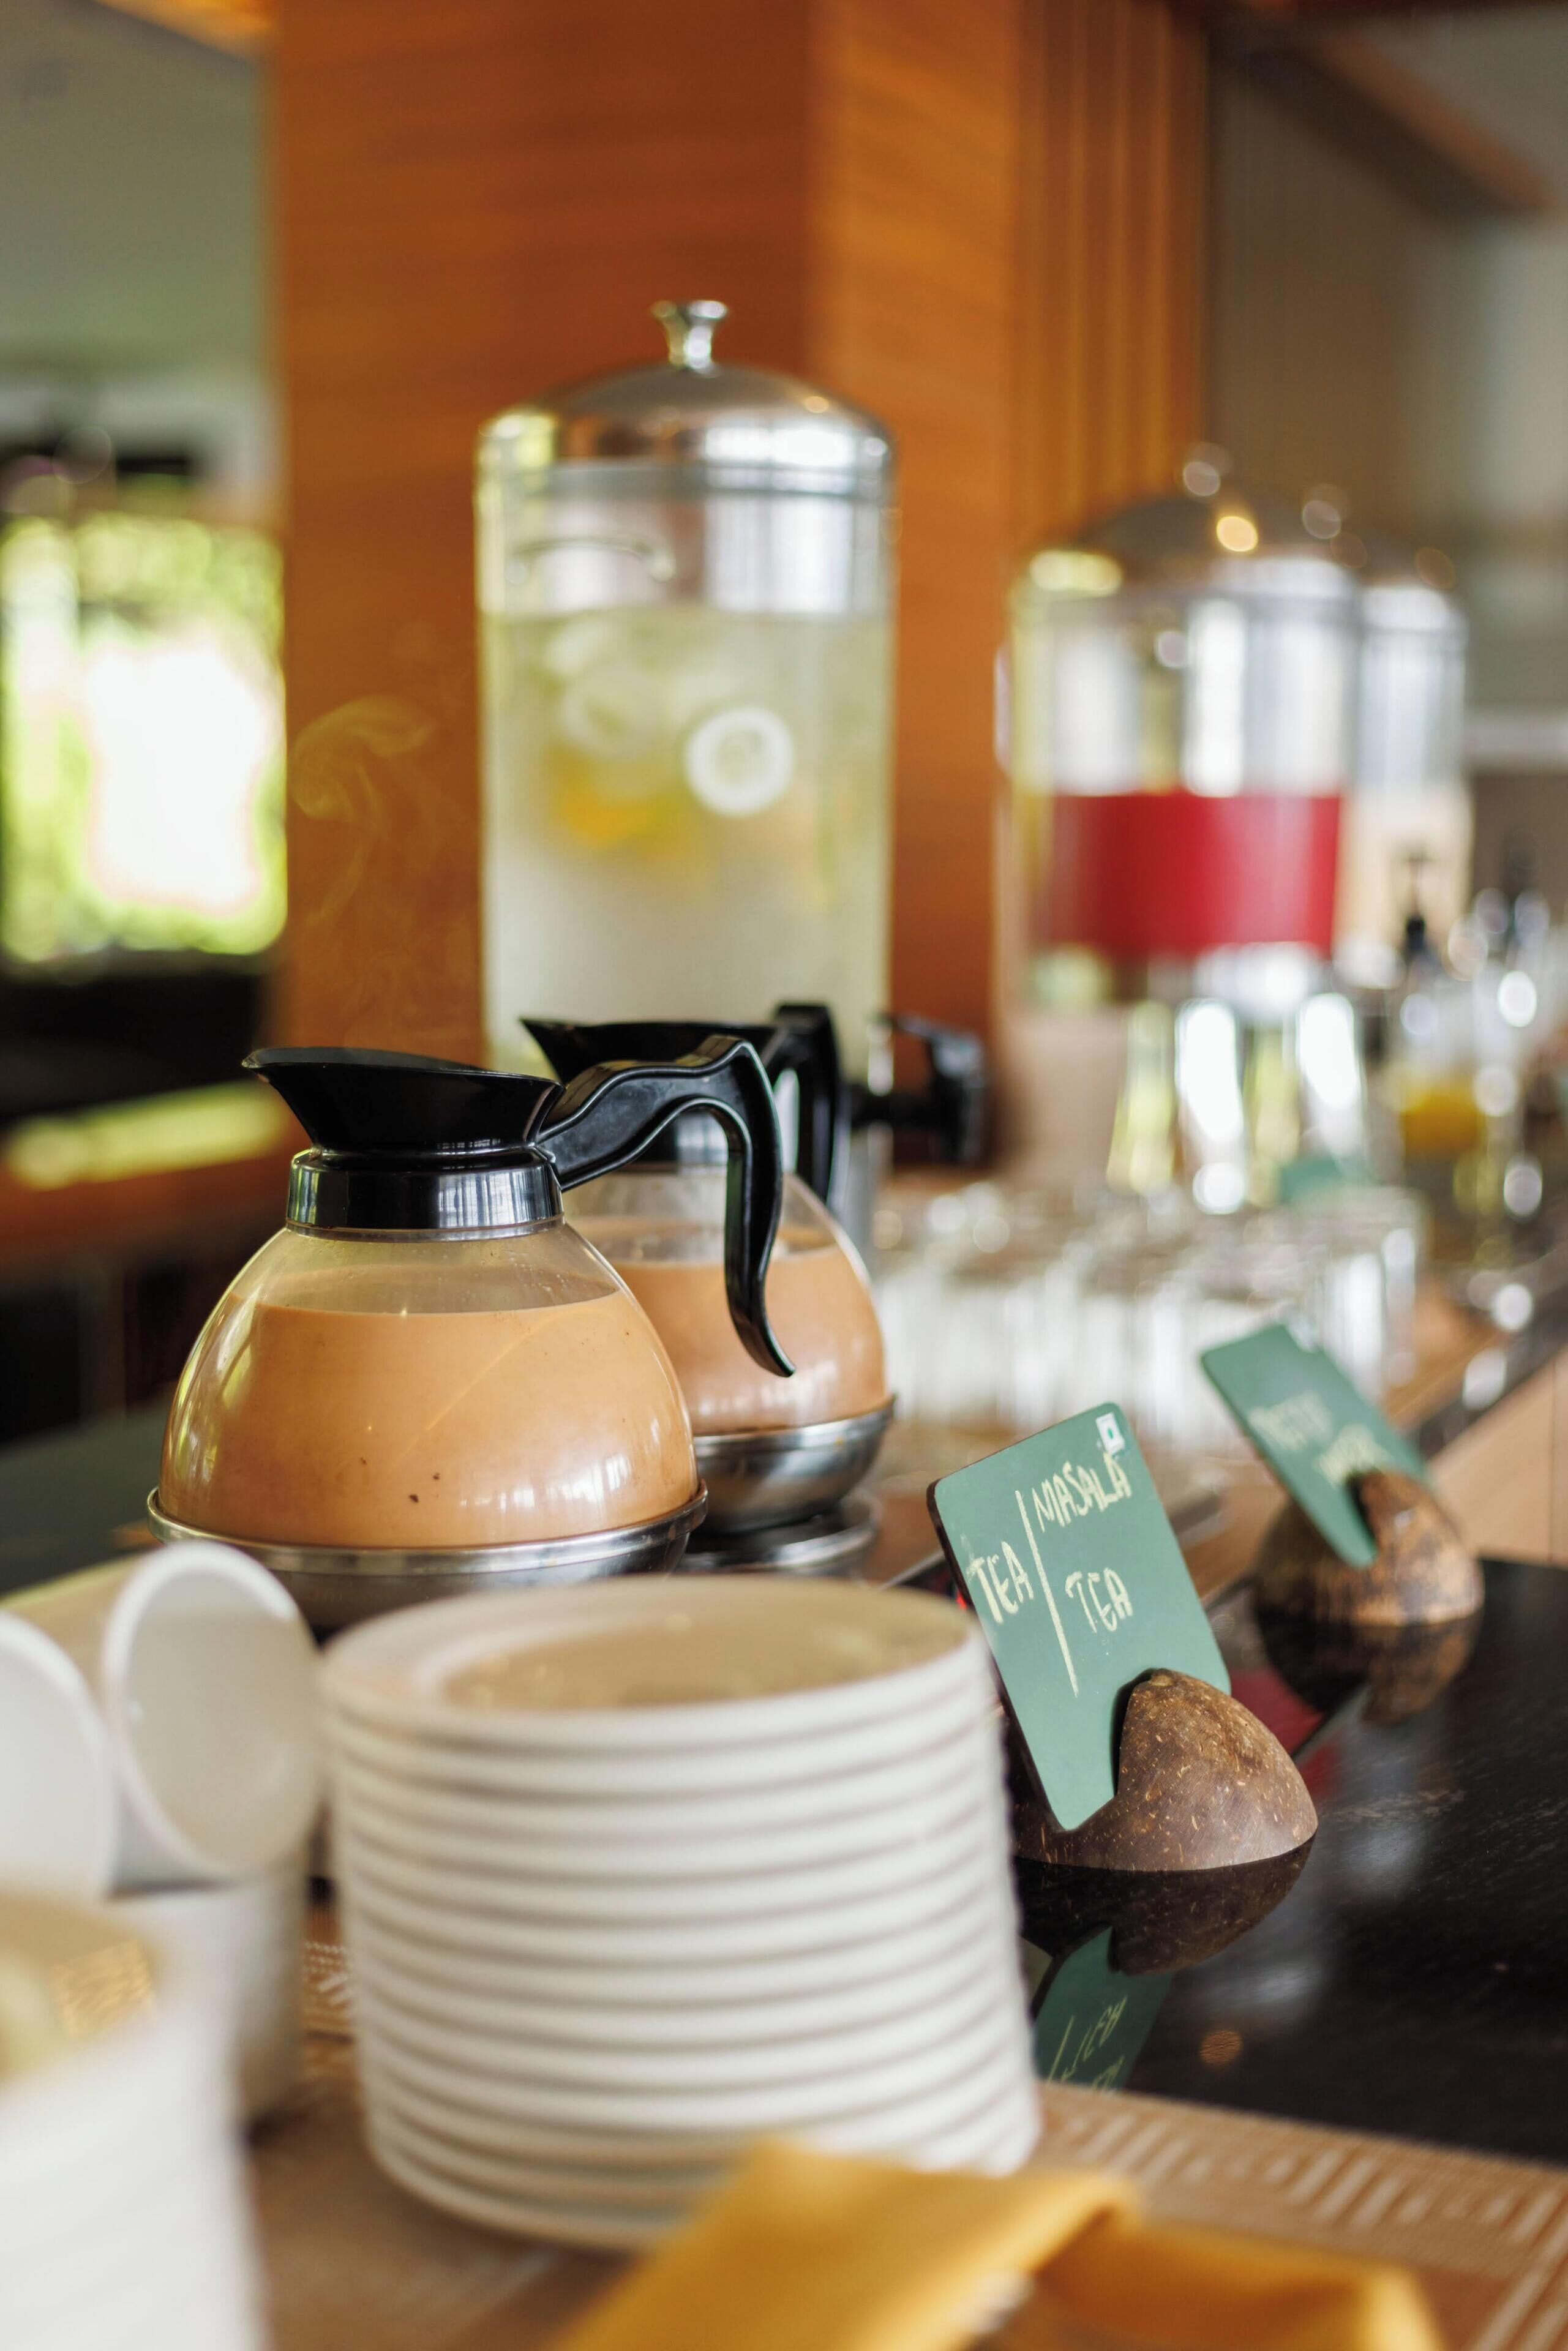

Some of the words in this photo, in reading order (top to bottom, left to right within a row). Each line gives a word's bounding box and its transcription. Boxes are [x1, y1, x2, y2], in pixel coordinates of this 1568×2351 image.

[1031, 1452, 1131, 1532] MASALA
[966, 1541, 1034, 1624] TEA
[1065, 1567, 1133, 1633] TEA
